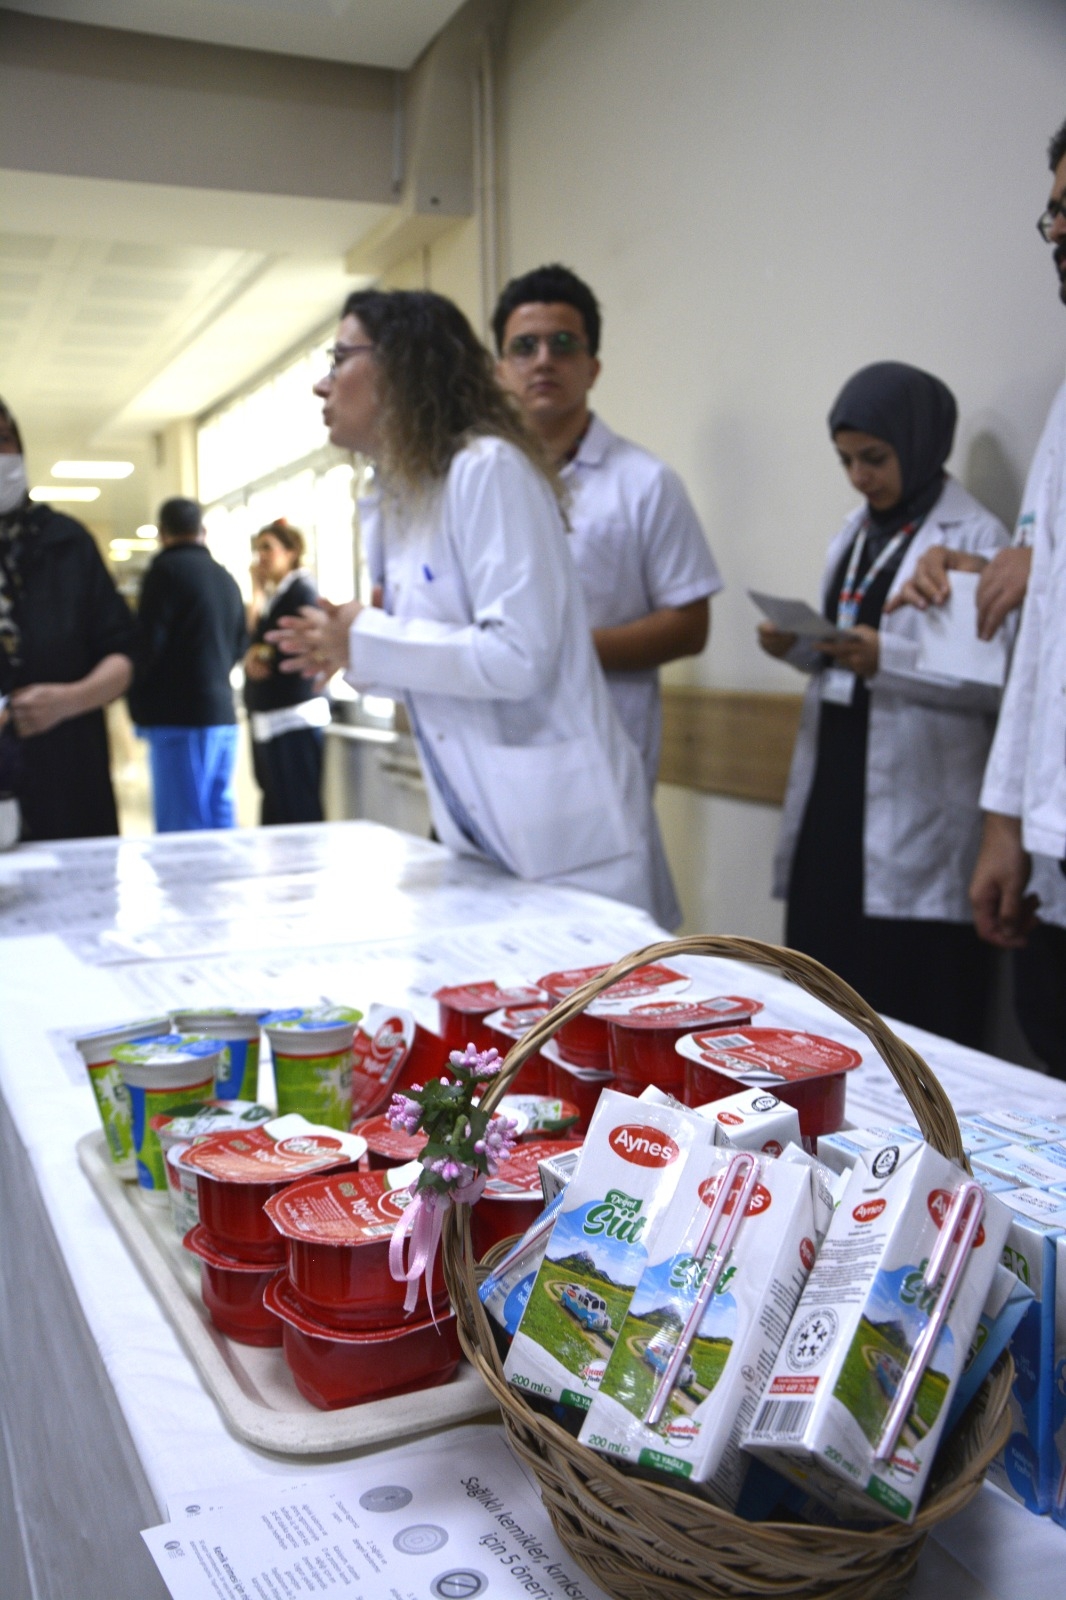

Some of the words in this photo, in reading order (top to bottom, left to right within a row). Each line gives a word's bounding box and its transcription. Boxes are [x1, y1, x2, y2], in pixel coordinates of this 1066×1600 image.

[614, 1130, 673, 1160] Aynes
[350, 1198, 384, 1226] Yoğurt
[583, 1204, 648, 1244] Süt
[855, 1203, 884, 1218] Aynes
[511, 1373, 530, 1386] 200
[588, 1434, 606, 1447] 200
[461, 1476, 504, 1513] Sağlıklı
[495, 1512, 549, 1564] kemikler,
[543, 1562, 588, 1600] kırıksı
[479, 1532, 506, 1555] için
[500, 1554, 520, 1565] 5
[510, 1566, 554, 1600] öneri
